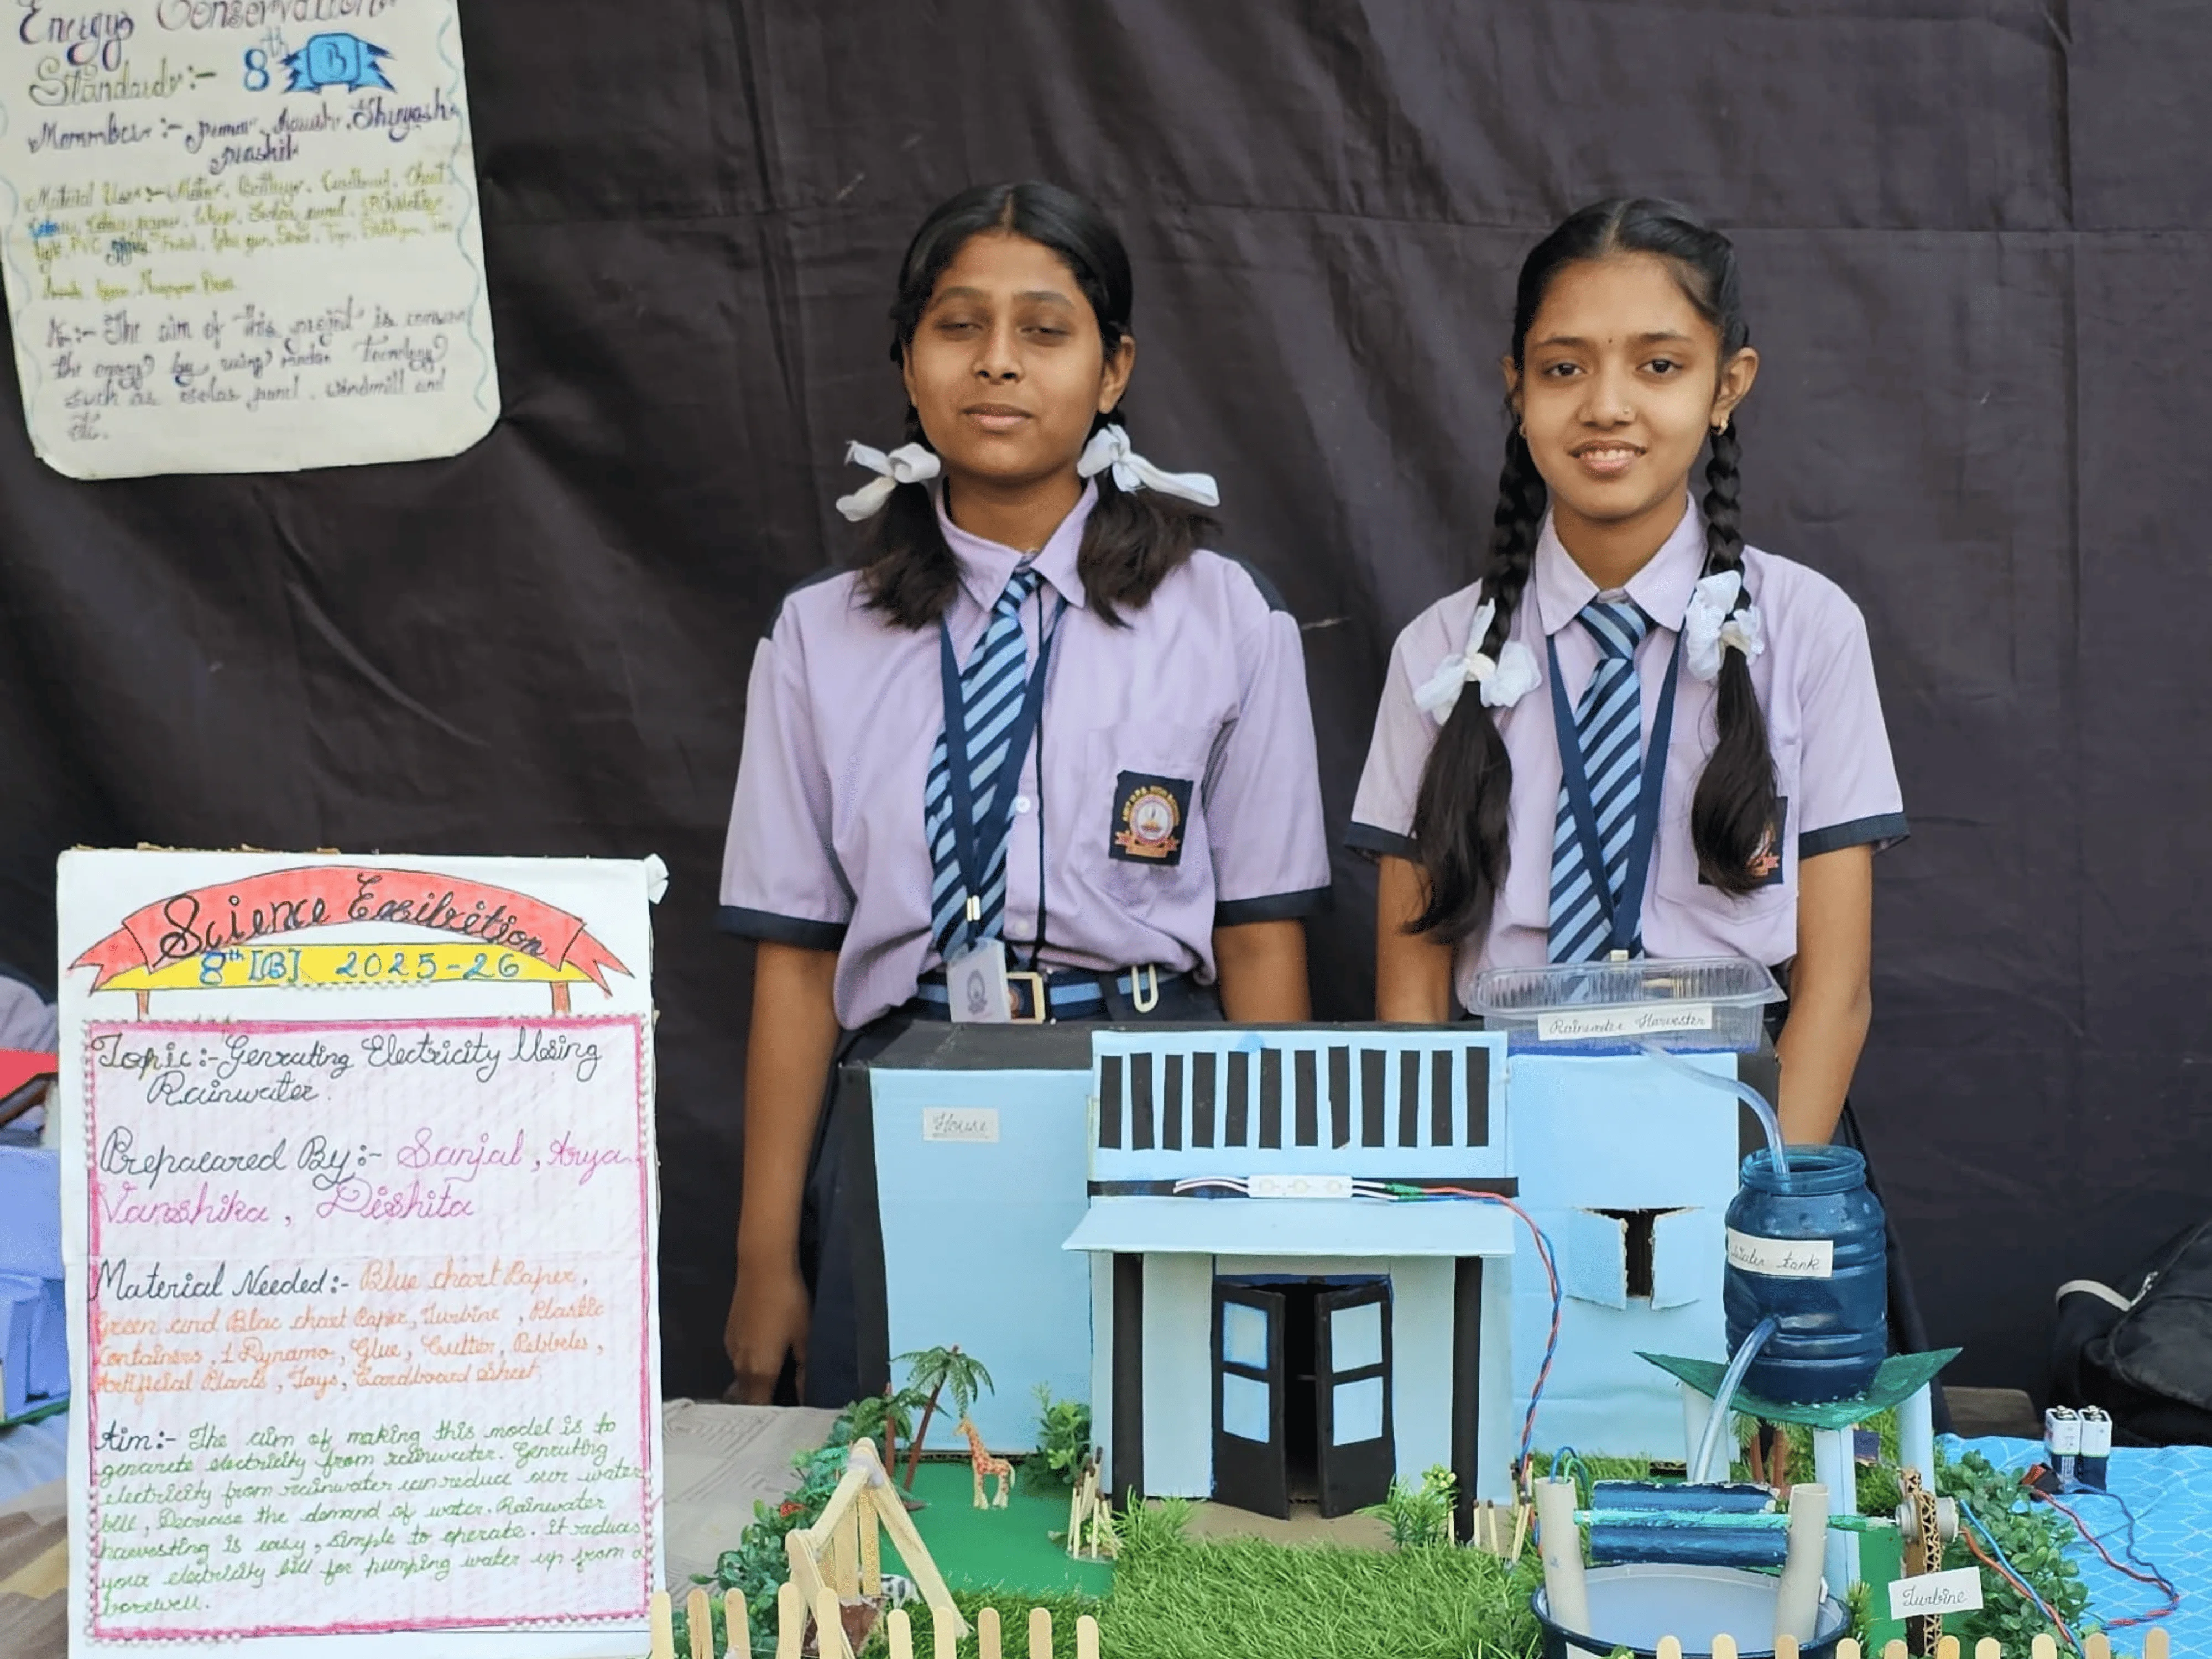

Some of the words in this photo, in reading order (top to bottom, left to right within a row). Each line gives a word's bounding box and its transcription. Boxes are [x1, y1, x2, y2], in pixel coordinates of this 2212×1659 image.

[152, 894, 331, 968] Science
[199, 948, 244, 986] 8th
[248, 948, 301, 983] [B]
[335, 950, 520, 981] 2025-26
[361, 1031, 501, 1083] Electricity
[507, 1026, 603, 1082] Using
[87, 1258, 223, 1303] Material
[359, 1258, 421, 1292] Blue
[428, 1256, 503, 1291] chart
[166, 1306, 222, 1335] and
[289, 1303, 348, 1330] chart
[188, 1421, 228, 1451] The
[246, 1425, 295, 1448] aim
[307, 1427, 333, 1455] of
[346, 1423, 421, 1452] making
[431, 1418, 476, 1443] this
[483, 1416, 554, 1438] model
[559, 1414, 583, 1437] is
[594, 1411, 618, 1436] to
[100, 1479, 212, 1509] electricity
[221, 1485, 274, 1509] from
[576, 1457, 646, 1484] water
[205, 1449, 306, 1481] electricity
[314, 1447, 376, 1479] from
[252, 1504, 288, 1525] the
[298, 1500, 382, 1524] demand
[387, 1501, 416, 1526] of
[495, 1488, 608, 1516] Rainwater
[221, 1533, 242, 1554] is
[407, 1522, 433, 1546] to
[274, 1558, 314, 1578] bill
[320, 1558, 352, 1587] for
[458, 1547, 521, 1568] water
[530, 1550, 564, 1574] up
[571, 1547, 625, 1573] from
[1902, 1584, 1968, 1607] Turbine
